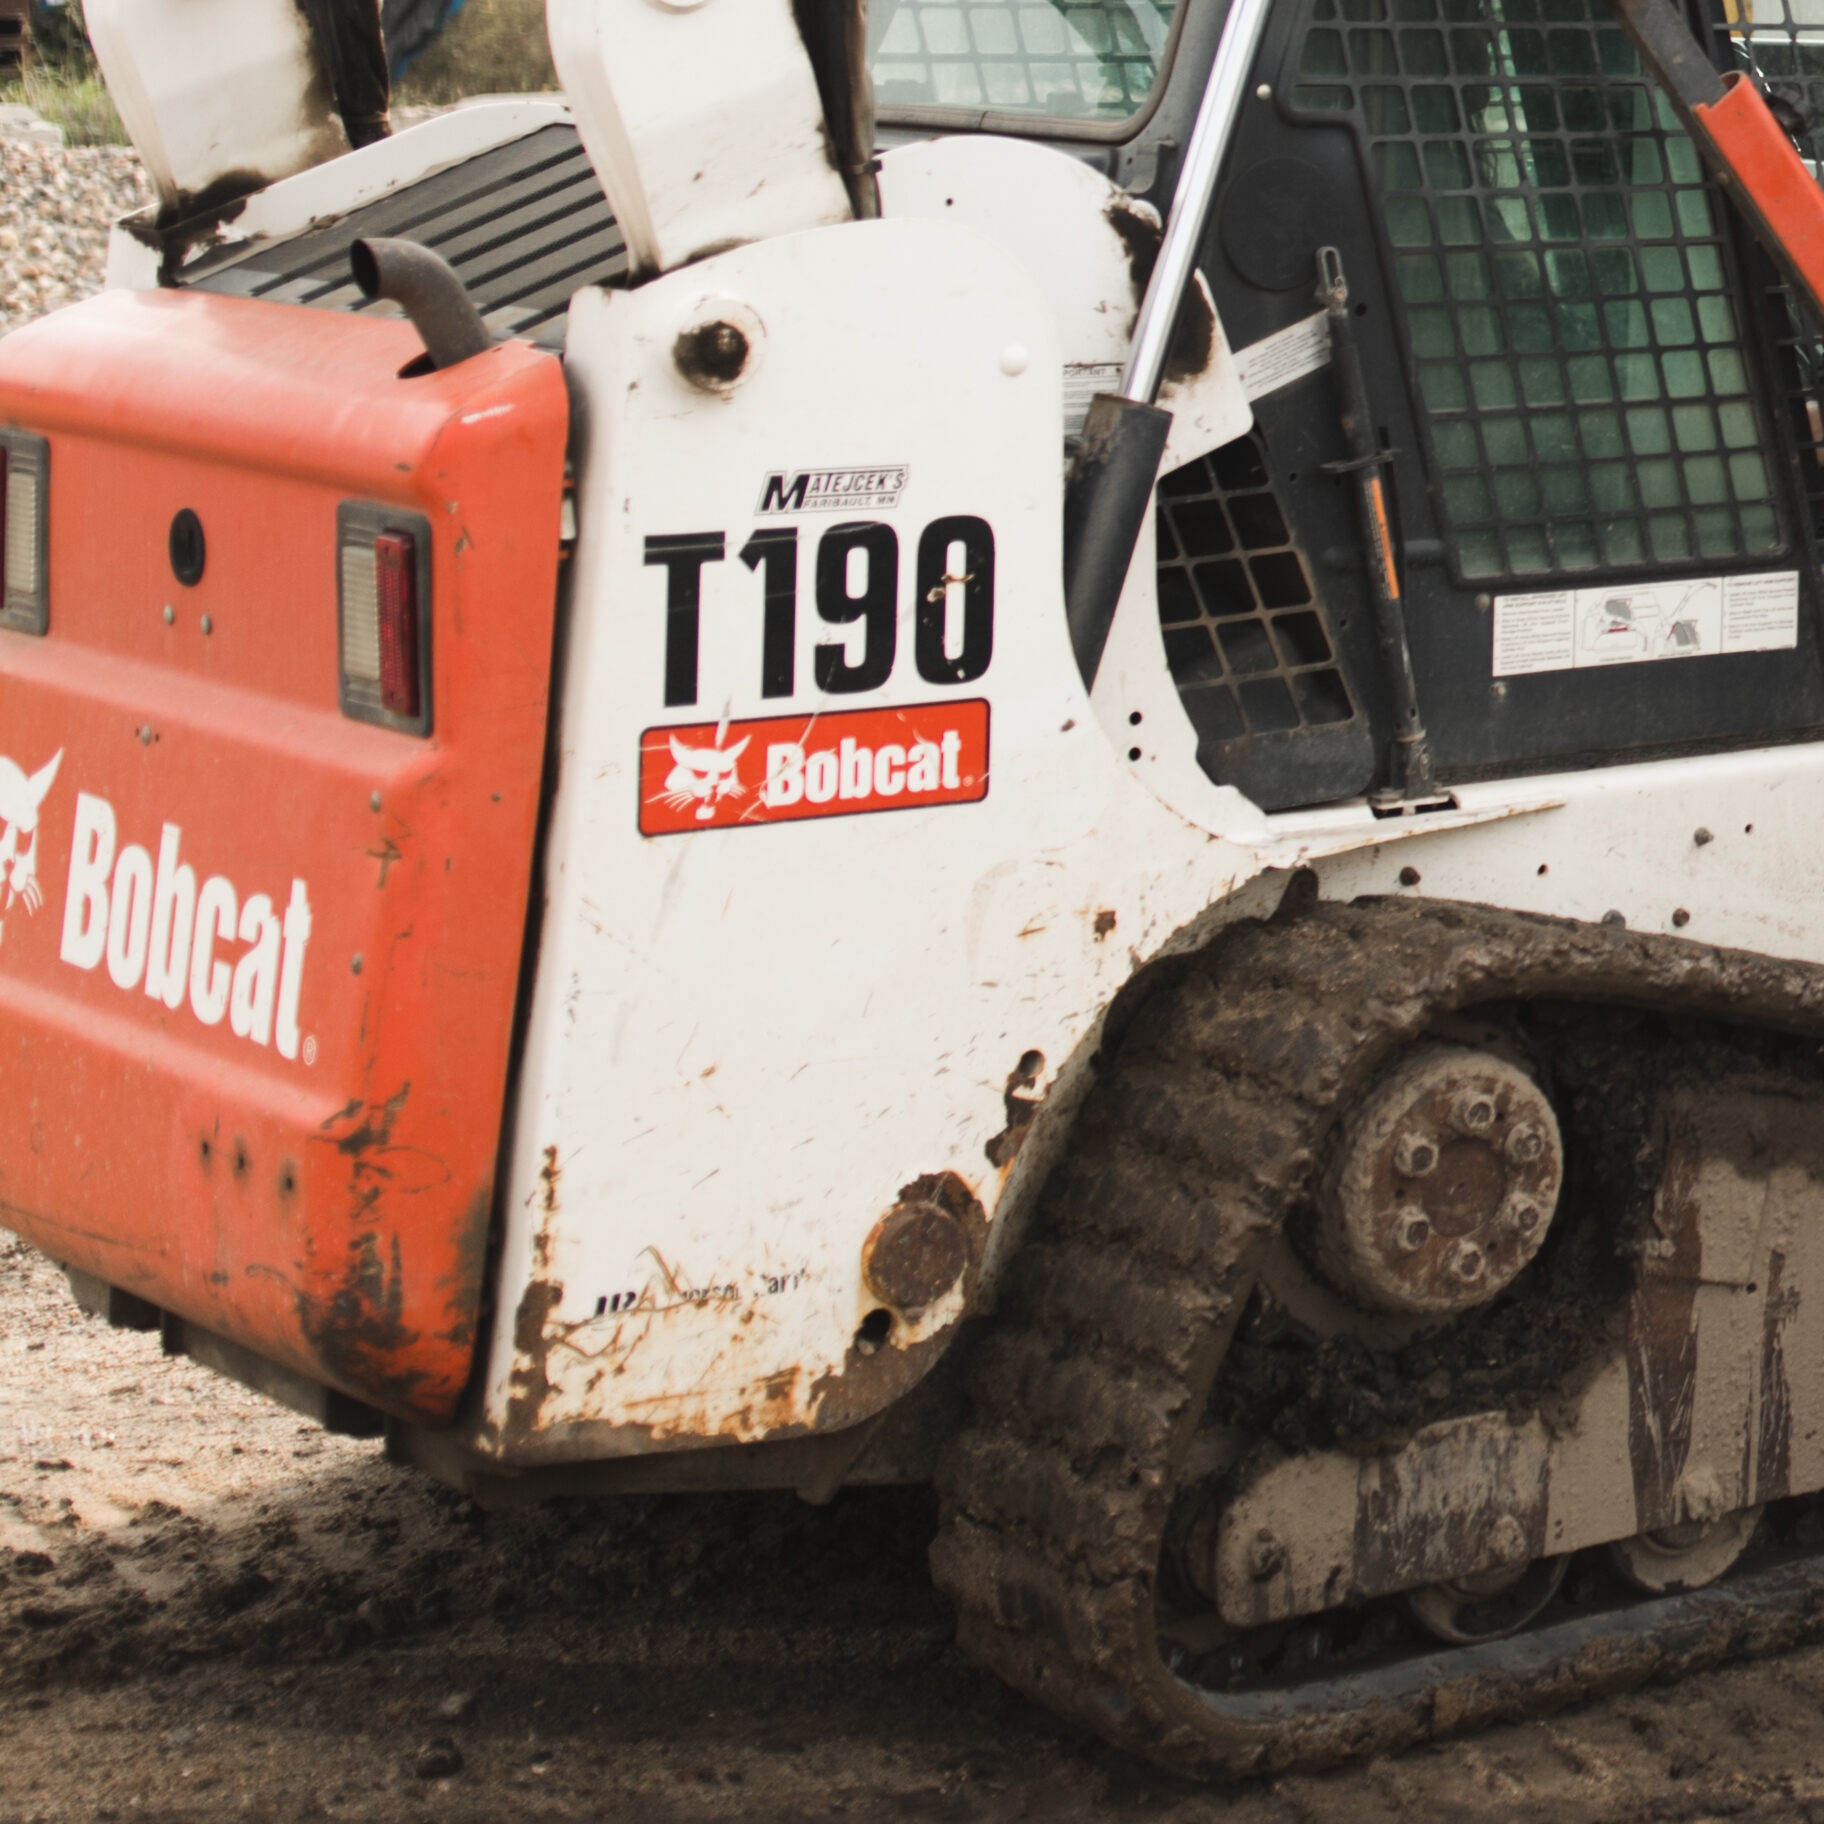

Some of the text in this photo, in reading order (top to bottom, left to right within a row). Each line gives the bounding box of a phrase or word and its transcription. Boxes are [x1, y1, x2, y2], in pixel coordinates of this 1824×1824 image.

[803, 495, 872, 509] FARIBAULT
[643, 514, 996, 709] T190
[764, 729, 962, 810] Bobcat
[59, 790, 313, 1061] Bobcat
